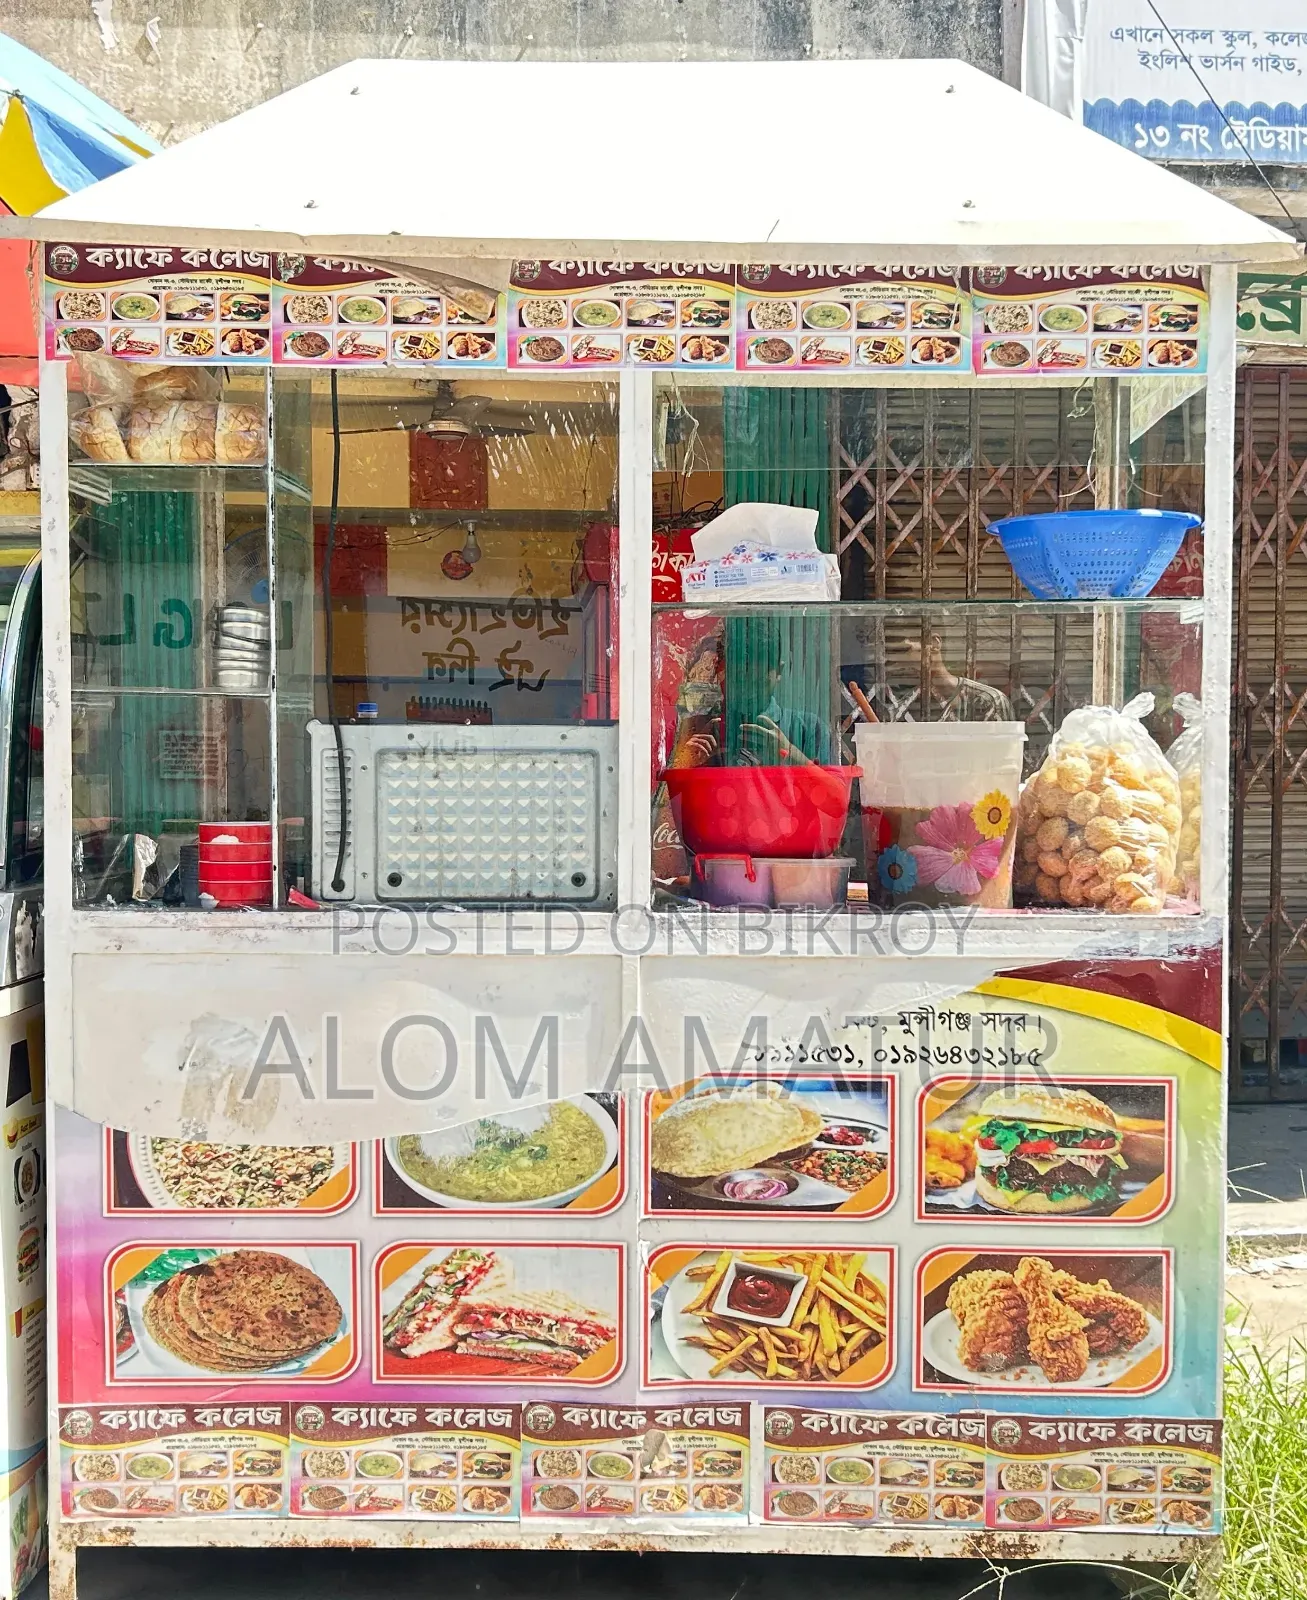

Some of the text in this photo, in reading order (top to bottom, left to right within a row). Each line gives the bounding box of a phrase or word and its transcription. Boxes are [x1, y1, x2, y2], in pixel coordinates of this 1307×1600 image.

[1110, 26, 1164, 43] এখানে
[1170, 29, 1214, 44] সকল
[1219, 30, 1258, 49] স্কুল,
[1137, 49, 1302, 76] ইংলিশ ভার্সন গাইড,
[1134, 122, 1170, 149] ১৩
[1177, 123, 1213, 152] নং
[86, 247, 174, 269] ক্যাফে
[180, 248, 270, 269] কলেজ
[874, 1044, 1043, 1068] ০১৯২৬৪৩২১৮৫
[99, 1408, 186, 1431] ক্যাফে
[194, 1406, 282, 1428] কলেজ
[331, 1407, 417, 1429] ক্যাফে
[425, 1407, 513, 1429] কলেজ
[562, 1406, 647, 1430] ক্যাফে
[654, 1406, 742, 1428] কলেজ
[801, 1412, 889, 1436] ক্যাফে
[896, 1414, 985, 1438] কলেজ
[1028, 1421, 1116, 1443] ক্যাফে
[1124, 1422, 1214, 1444] কলেজ
